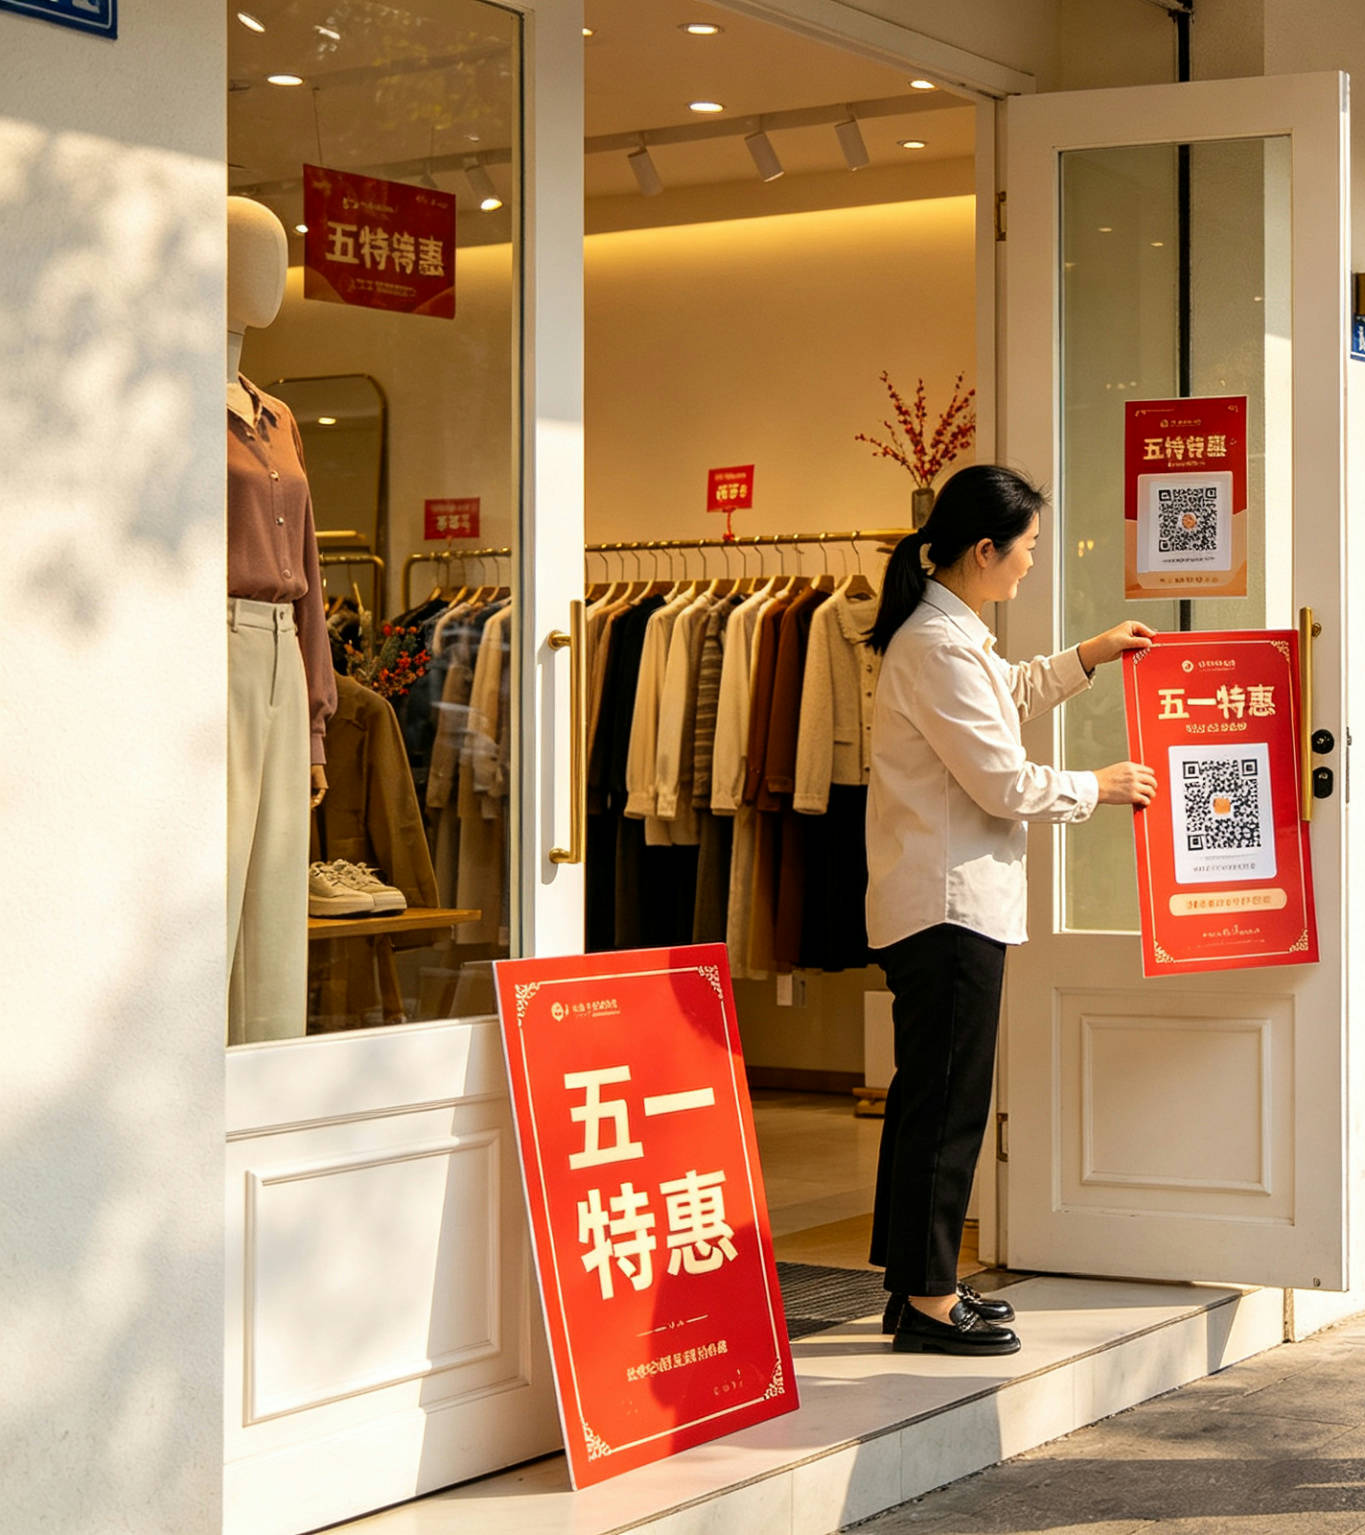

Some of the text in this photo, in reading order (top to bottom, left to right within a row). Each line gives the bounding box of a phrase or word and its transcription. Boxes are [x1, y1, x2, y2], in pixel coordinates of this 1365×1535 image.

[1158, 684, 1275, 720] 五一特惠
[564, 1065, 715, 1170] 五一
[577, 1170, 738, 1299] 特惠
